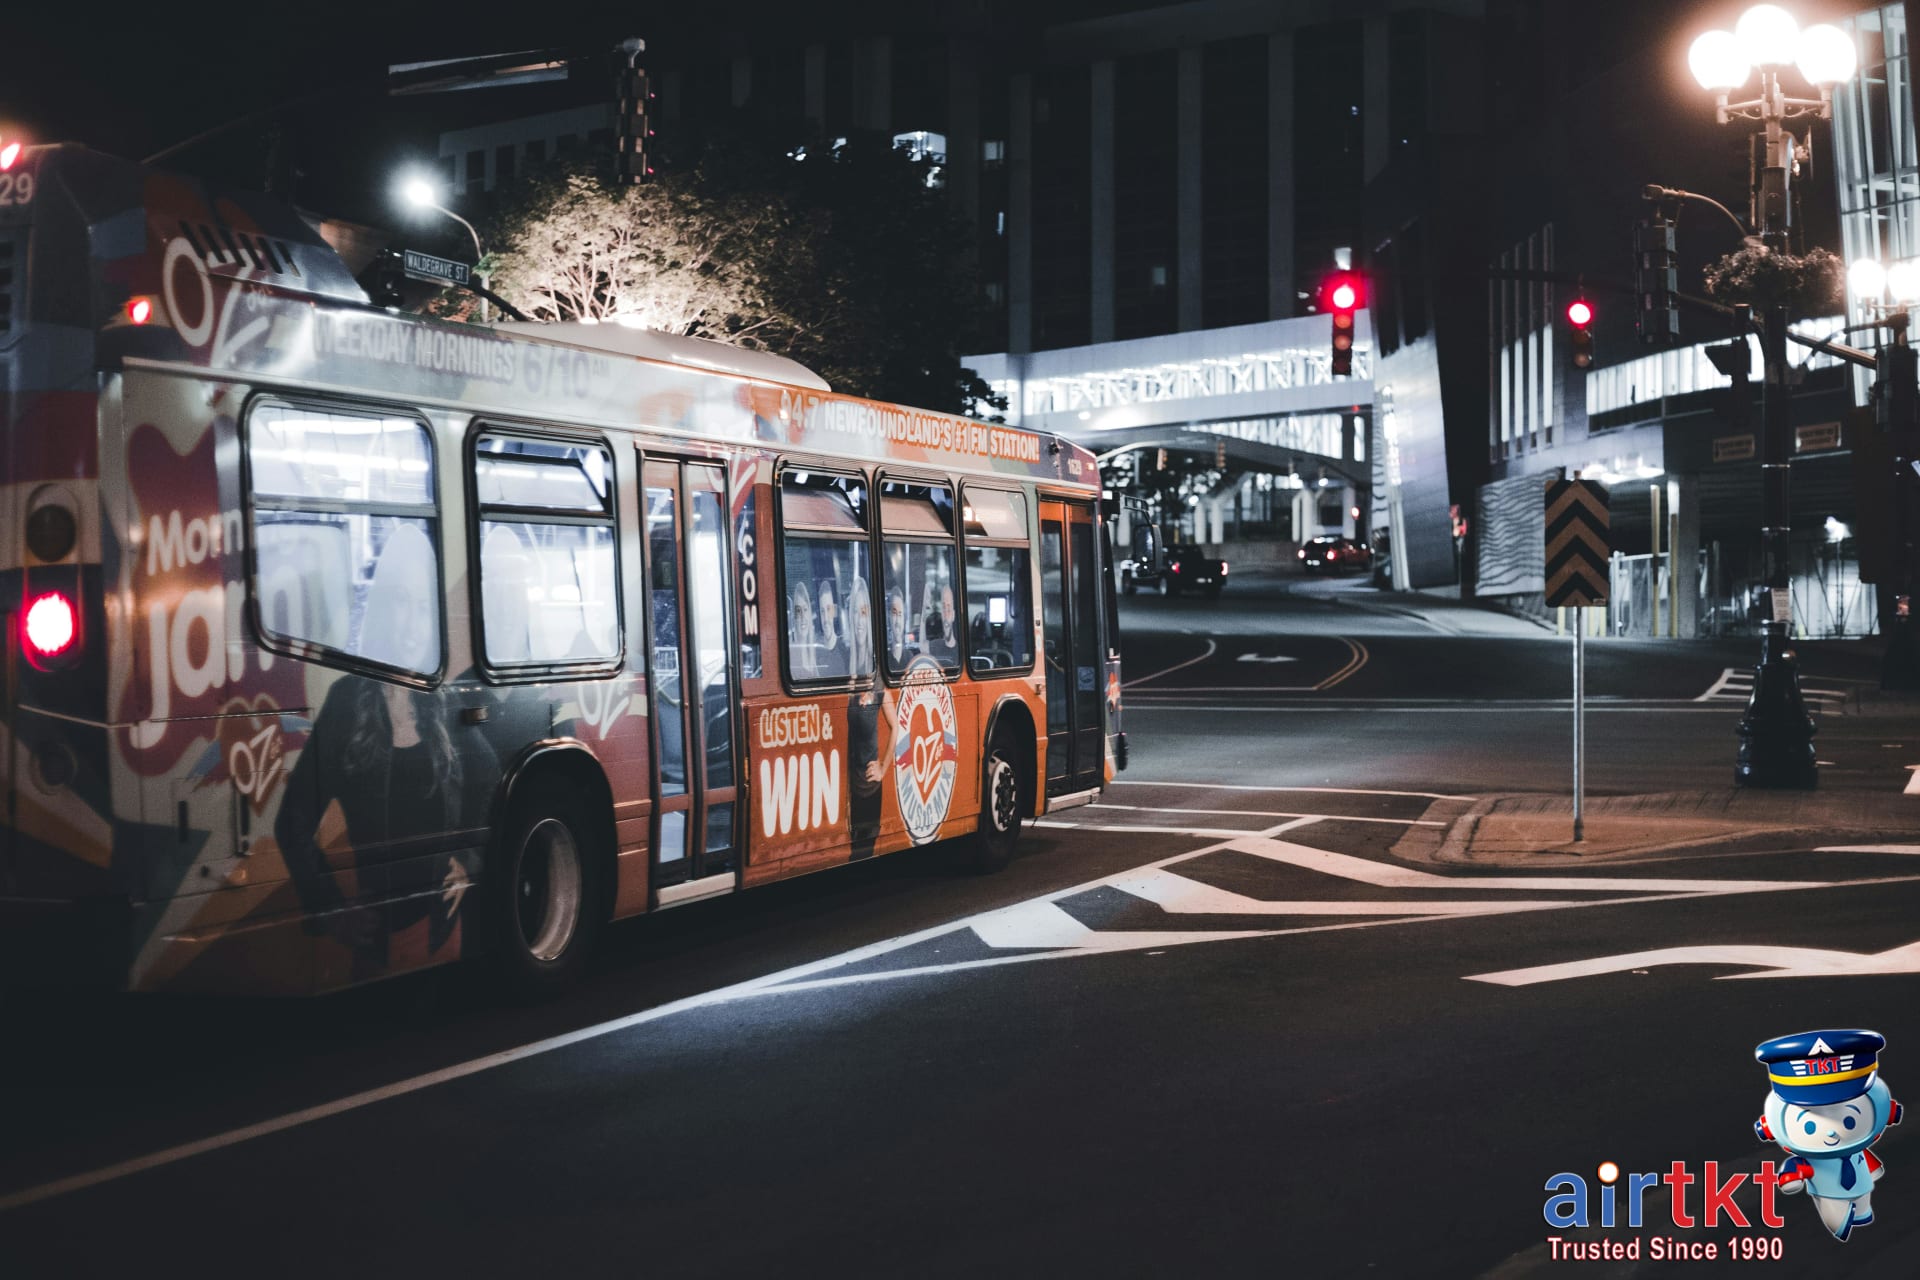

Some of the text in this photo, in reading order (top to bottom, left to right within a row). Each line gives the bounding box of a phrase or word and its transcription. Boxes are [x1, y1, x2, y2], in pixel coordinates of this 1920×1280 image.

[407, 253, 465, 280] WALDEGRAVE ST
[314, 313, 411, 366] WEEKDAY
[415, 328, 515, 381] MORNINGS
[780, 389, 1040, 461] 94.7 NEWFOUNDLAND'S #1 FM STATION!
[760, 703, 833, 749] LISTEN &
[760, 748, 840, 838] WIN
[913, 731, 942, 793] OZ
